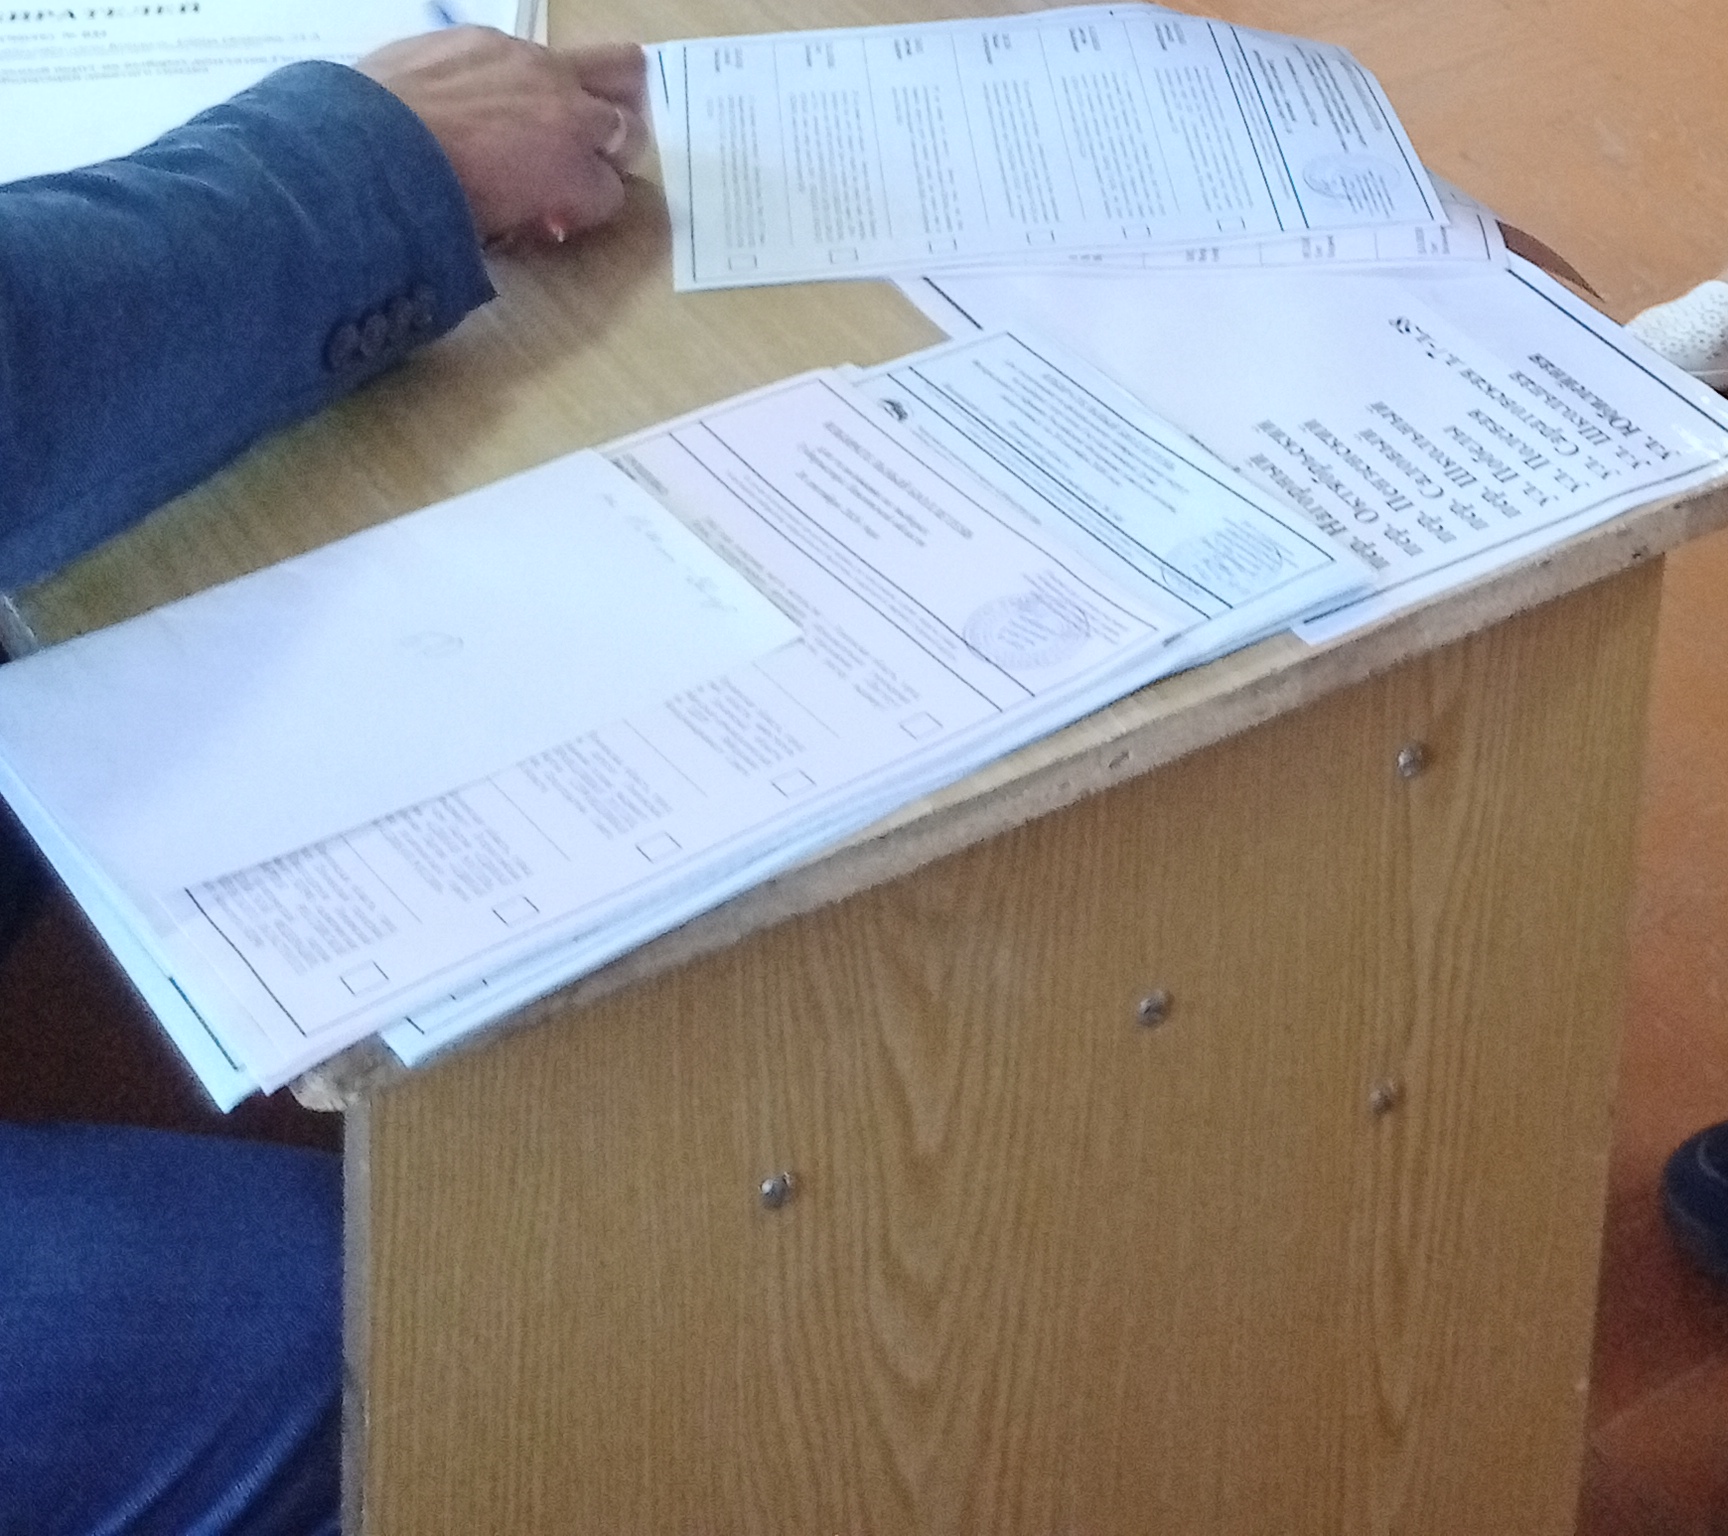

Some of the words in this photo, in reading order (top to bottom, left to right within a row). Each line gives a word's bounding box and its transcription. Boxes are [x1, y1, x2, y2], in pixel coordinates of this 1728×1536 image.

[1458, 367, 1579, 456] Саратовская
[1508, 369, 1612, 446] Школьная
[1526, 352, 1642, 438] Юбилейная
[1298, 418, 1415, 512] Пензенский
[1353, 427, 1444, 499] Садовый
[1364, 400, 1478, 488] Школьный
[1442, 424, 1520, 484] Победы
[1466, 408, 1551, 471] Полевая
[1584, 455, 1620, 480] ул.
[1615, 444, 1651, 470] ул.
[1644, 435, 1681, 461] ул.
[1245, 452, 1348, 538] Нагорный
[1251, 418, 1379, 524] Октябрьский
[1522, 480, 1559, 507] ул.
[1553, 467, 1590, 493] ул.
[1416, 509, 1457, 544] пер.
[1448, 497, 1489, 531] пер.
[1480, 485, 1521, 518] пер.
[1382, 522, 1424, 557] пер.
